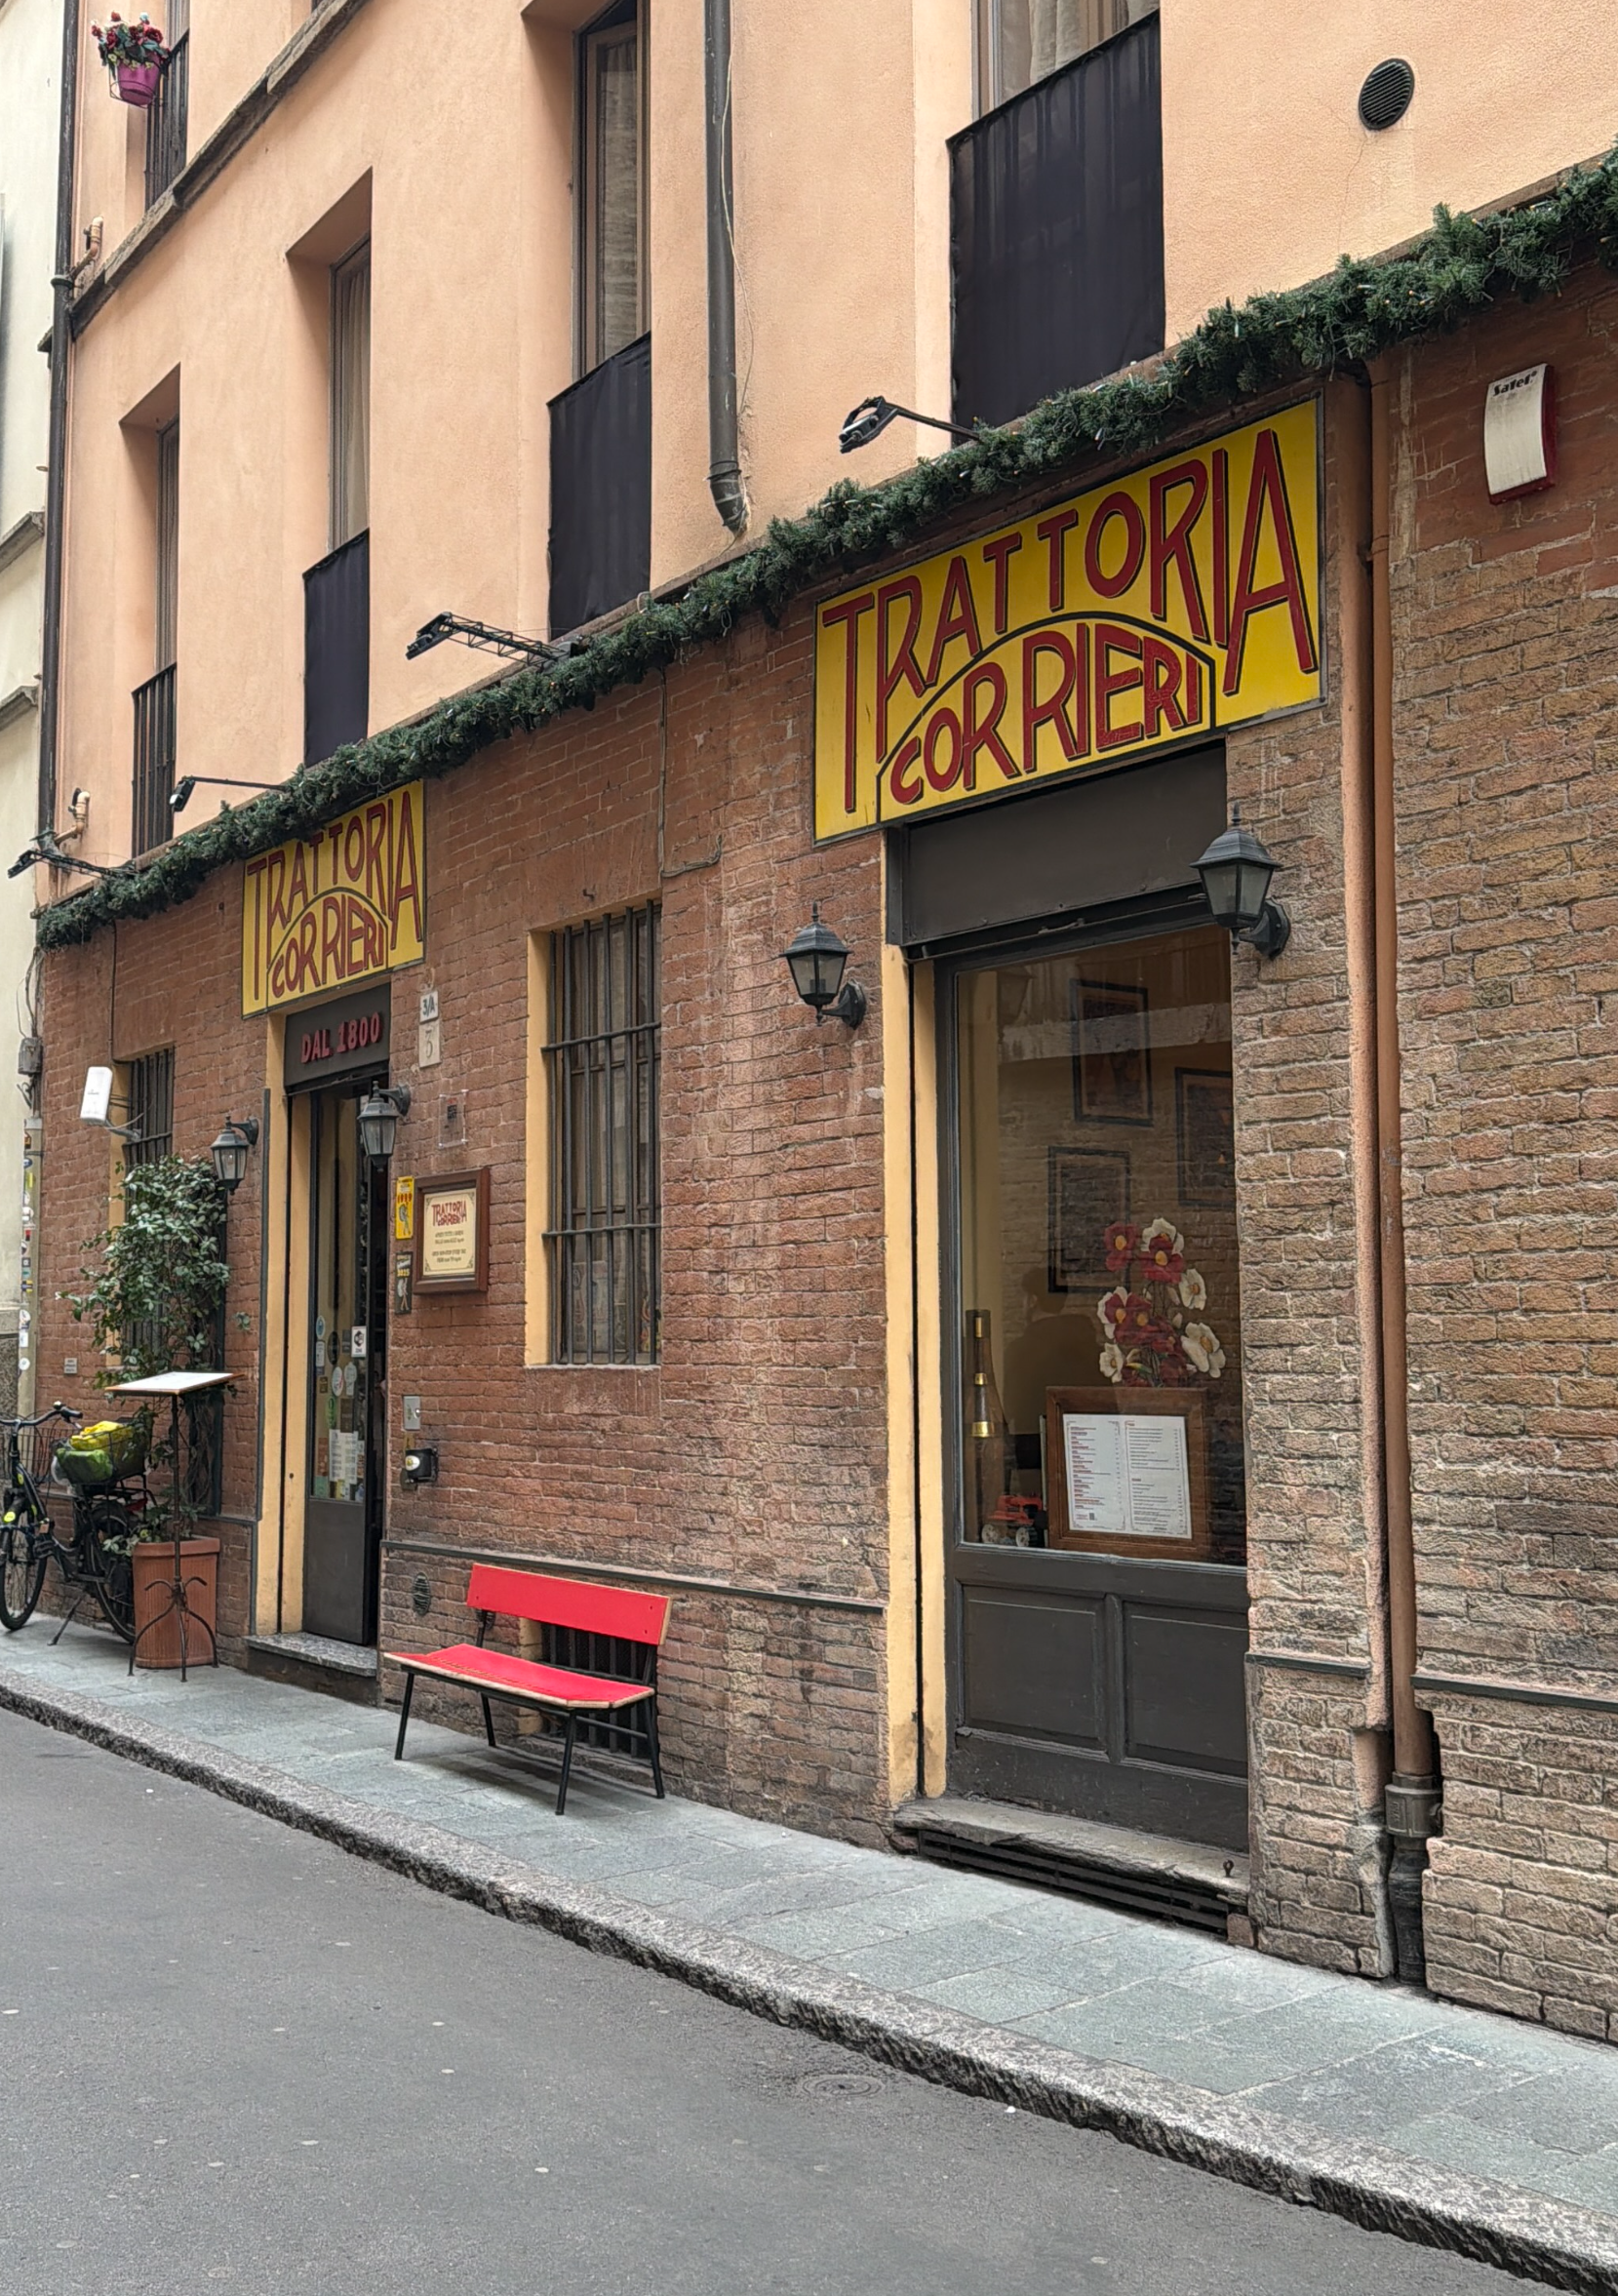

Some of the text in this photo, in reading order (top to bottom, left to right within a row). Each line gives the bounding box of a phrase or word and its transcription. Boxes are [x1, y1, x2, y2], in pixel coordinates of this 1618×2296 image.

[822, 428, 1319, 813] TRATTORIA
[889, 622, 1204, 805] CORRIERI
[247, 790, 423, 1001] TRATTORIA
[271, 893, 384, 999] CORRIERI
[300, 1011, 381, 1064] DAL 1800
[422, 995, 435, 1017] 3/A
[431, 1200, 467, 1227] TRATTORIA
